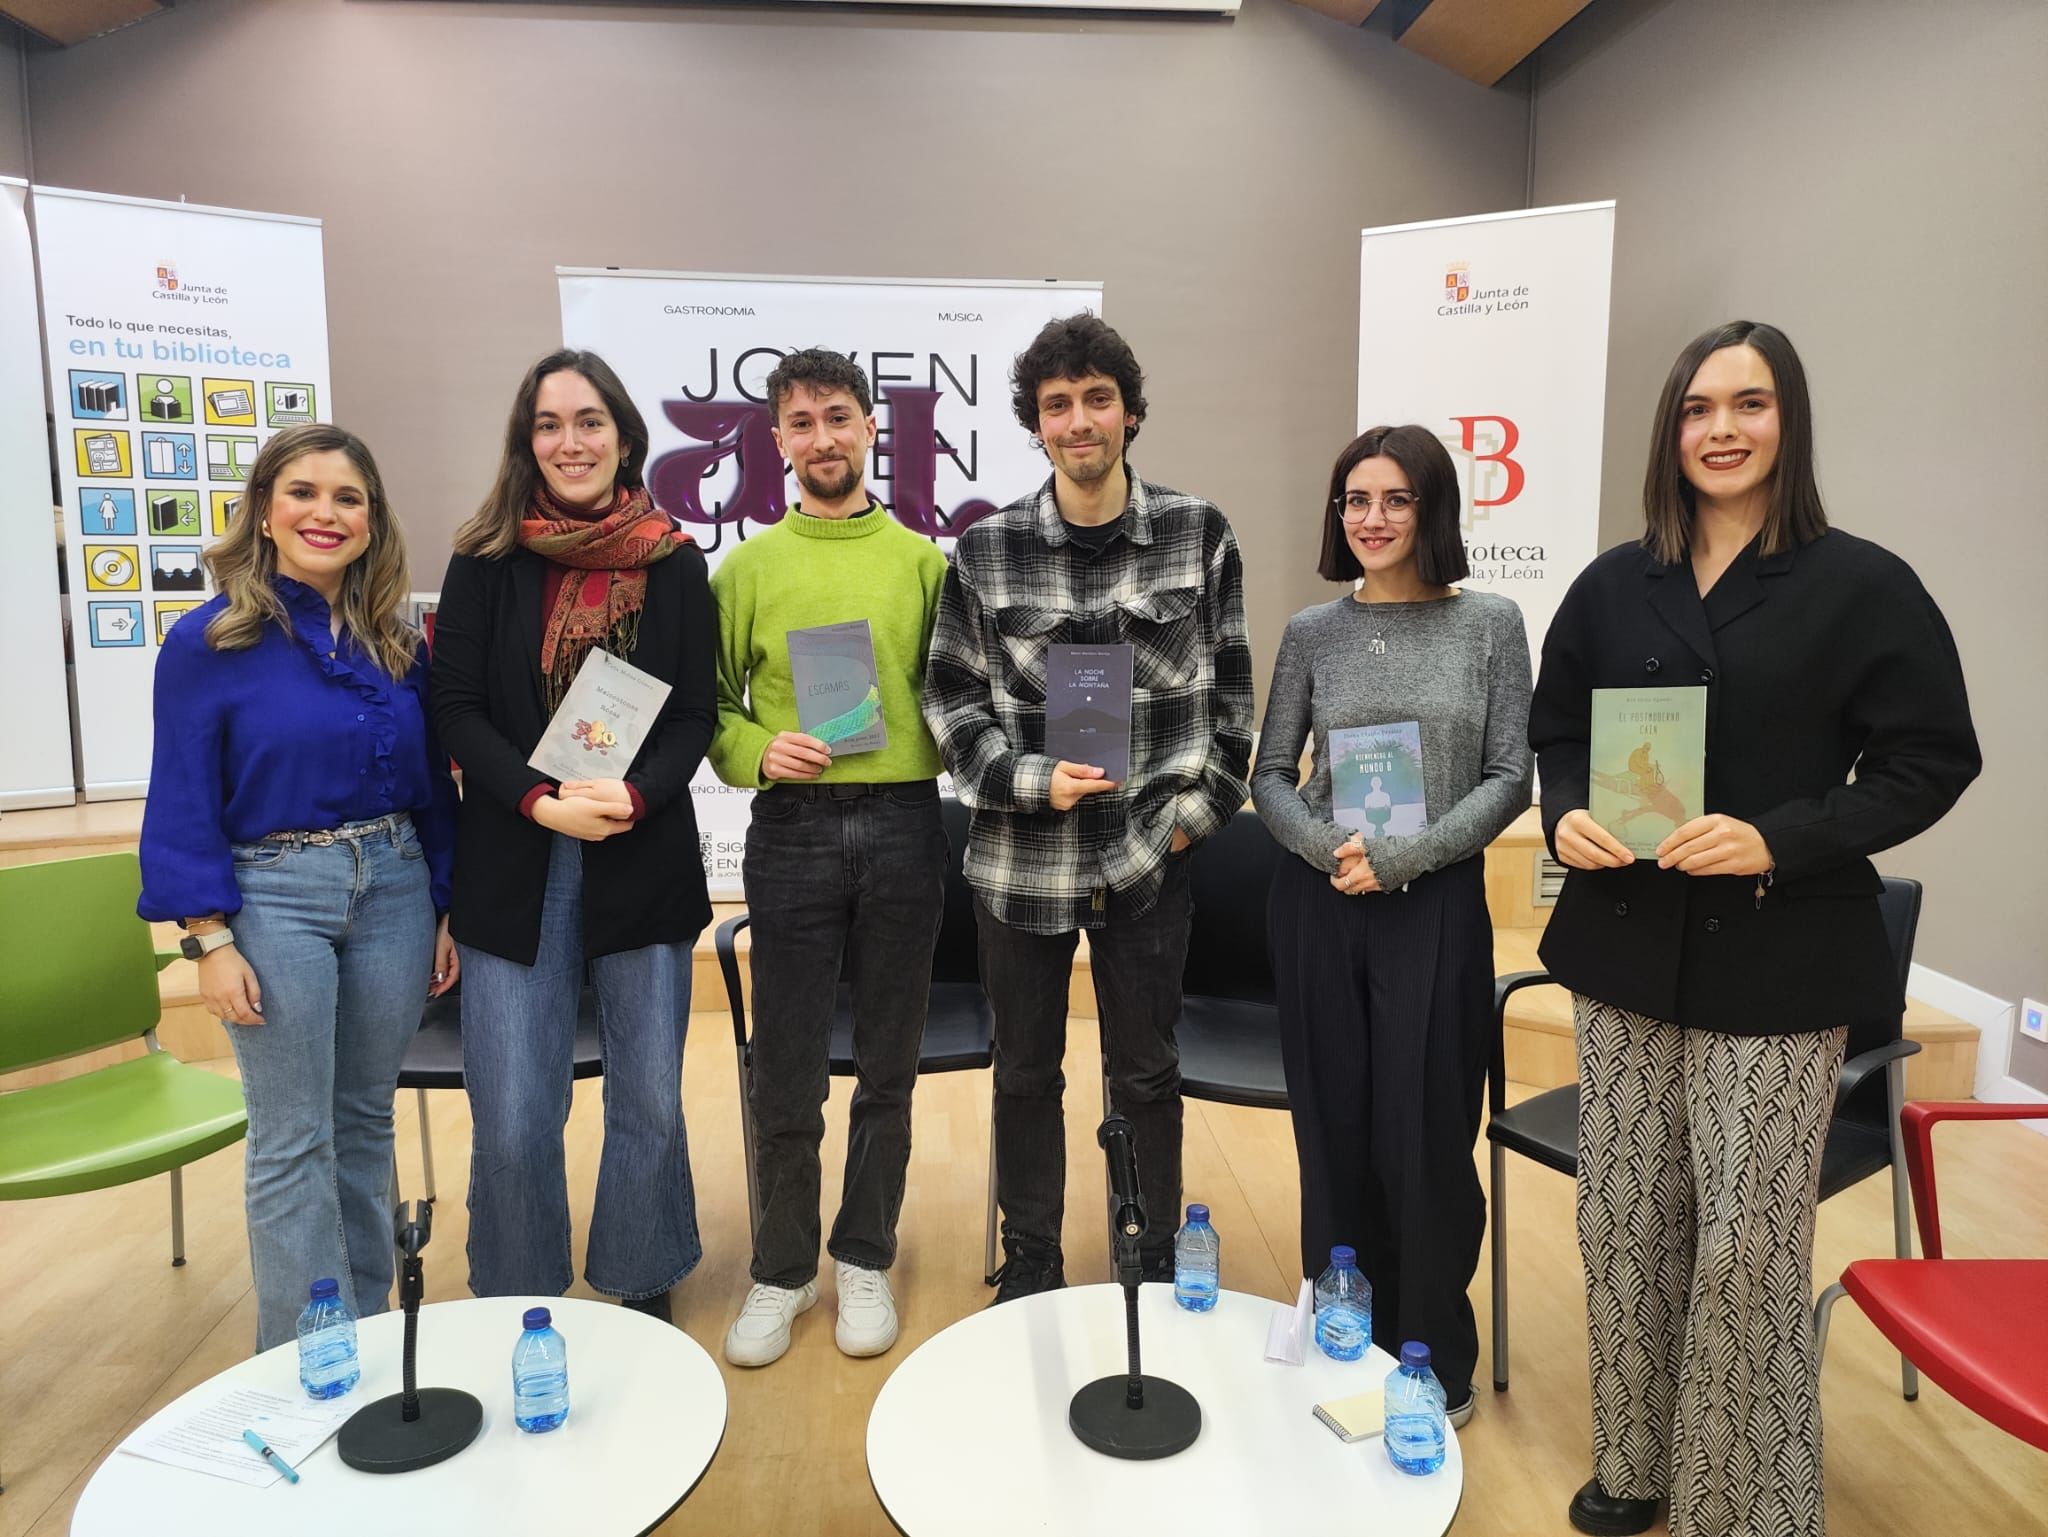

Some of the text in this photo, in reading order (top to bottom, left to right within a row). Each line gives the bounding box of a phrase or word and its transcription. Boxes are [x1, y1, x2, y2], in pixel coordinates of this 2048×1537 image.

[152, 290, 229, 305] Castilla y León
[181, 283, 228, 295] Junta de
[1472, 285, 1529, 300] Junta de
[1437, 299, 1529, 317] Castilla y León
[65, 314, 232, 340] Todo lo que necesitas,
[69, 337, 291, 369] en tu biblioteca
[681, 346, 978, 407] JOEN
[1464, 540, 1548, 562] ioteca
[1487, 569, 1498, 585] y
[1501, 564, 1545, 580] León
[717, 858, 738, 869] EN
